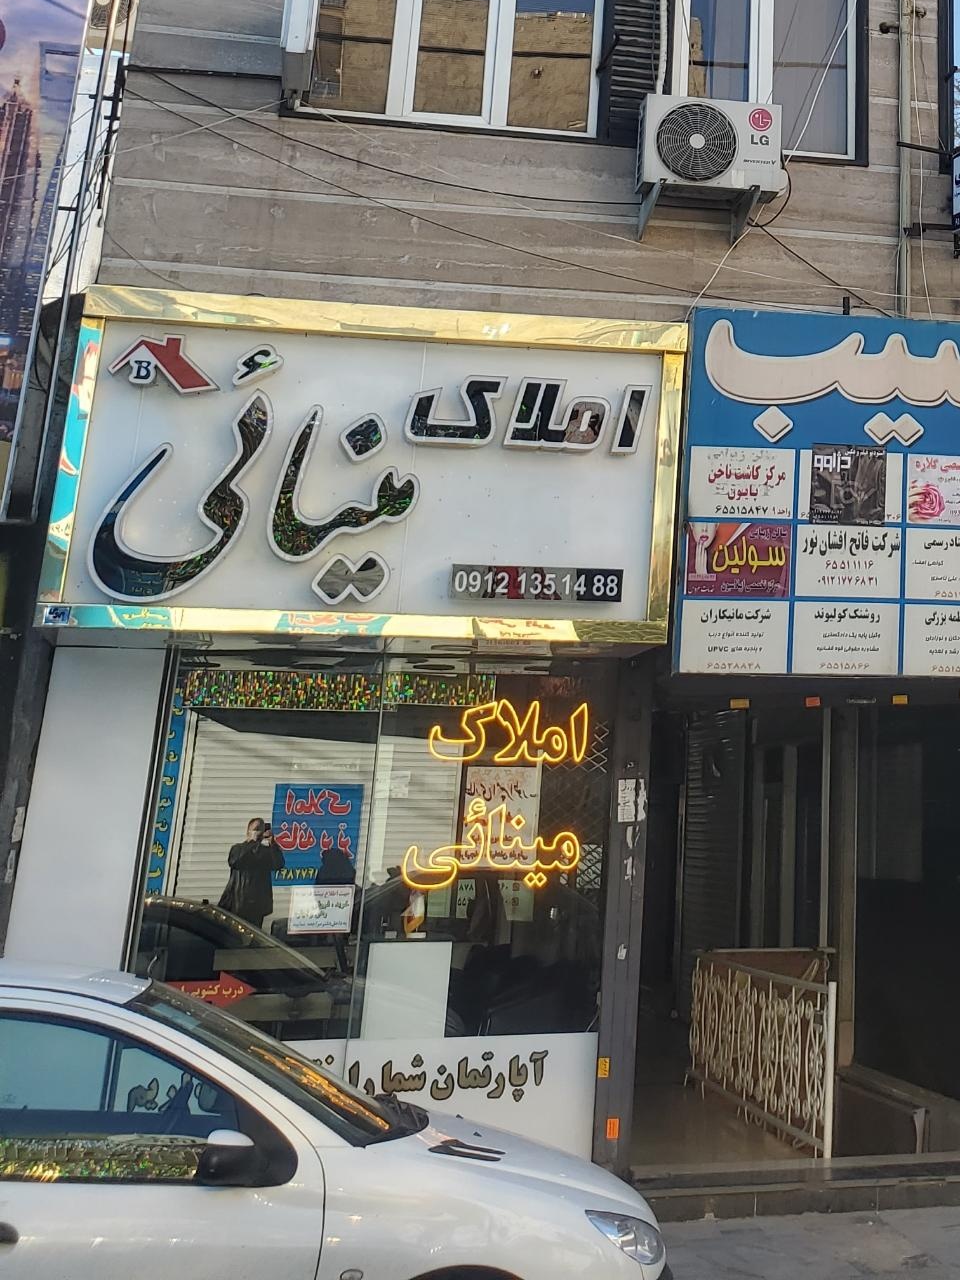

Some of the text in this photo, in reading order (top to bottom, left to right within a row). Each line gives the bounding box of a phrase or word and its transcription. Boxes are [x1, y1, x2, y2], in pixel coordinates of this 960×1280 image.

[750, 134, 769, 146] LG
[405, 374, 652, 456] املاک
[712, 536, 786, 574] سولین
[802, 529, 818, 555] نور
[871, 532, 900, 558] شرکت
[923, 539, 949, 550] رسمی
[454, 570, 618, 597] 0912 135 14 88
[744, 608, 772, 624] شرکت
[428, 698, 589, 763] املاک
[402, 797, 581, 889] مینائی
[380, 1053, 427, 1096] شما
[429, 1050, 548, 1102] آپارتمان
